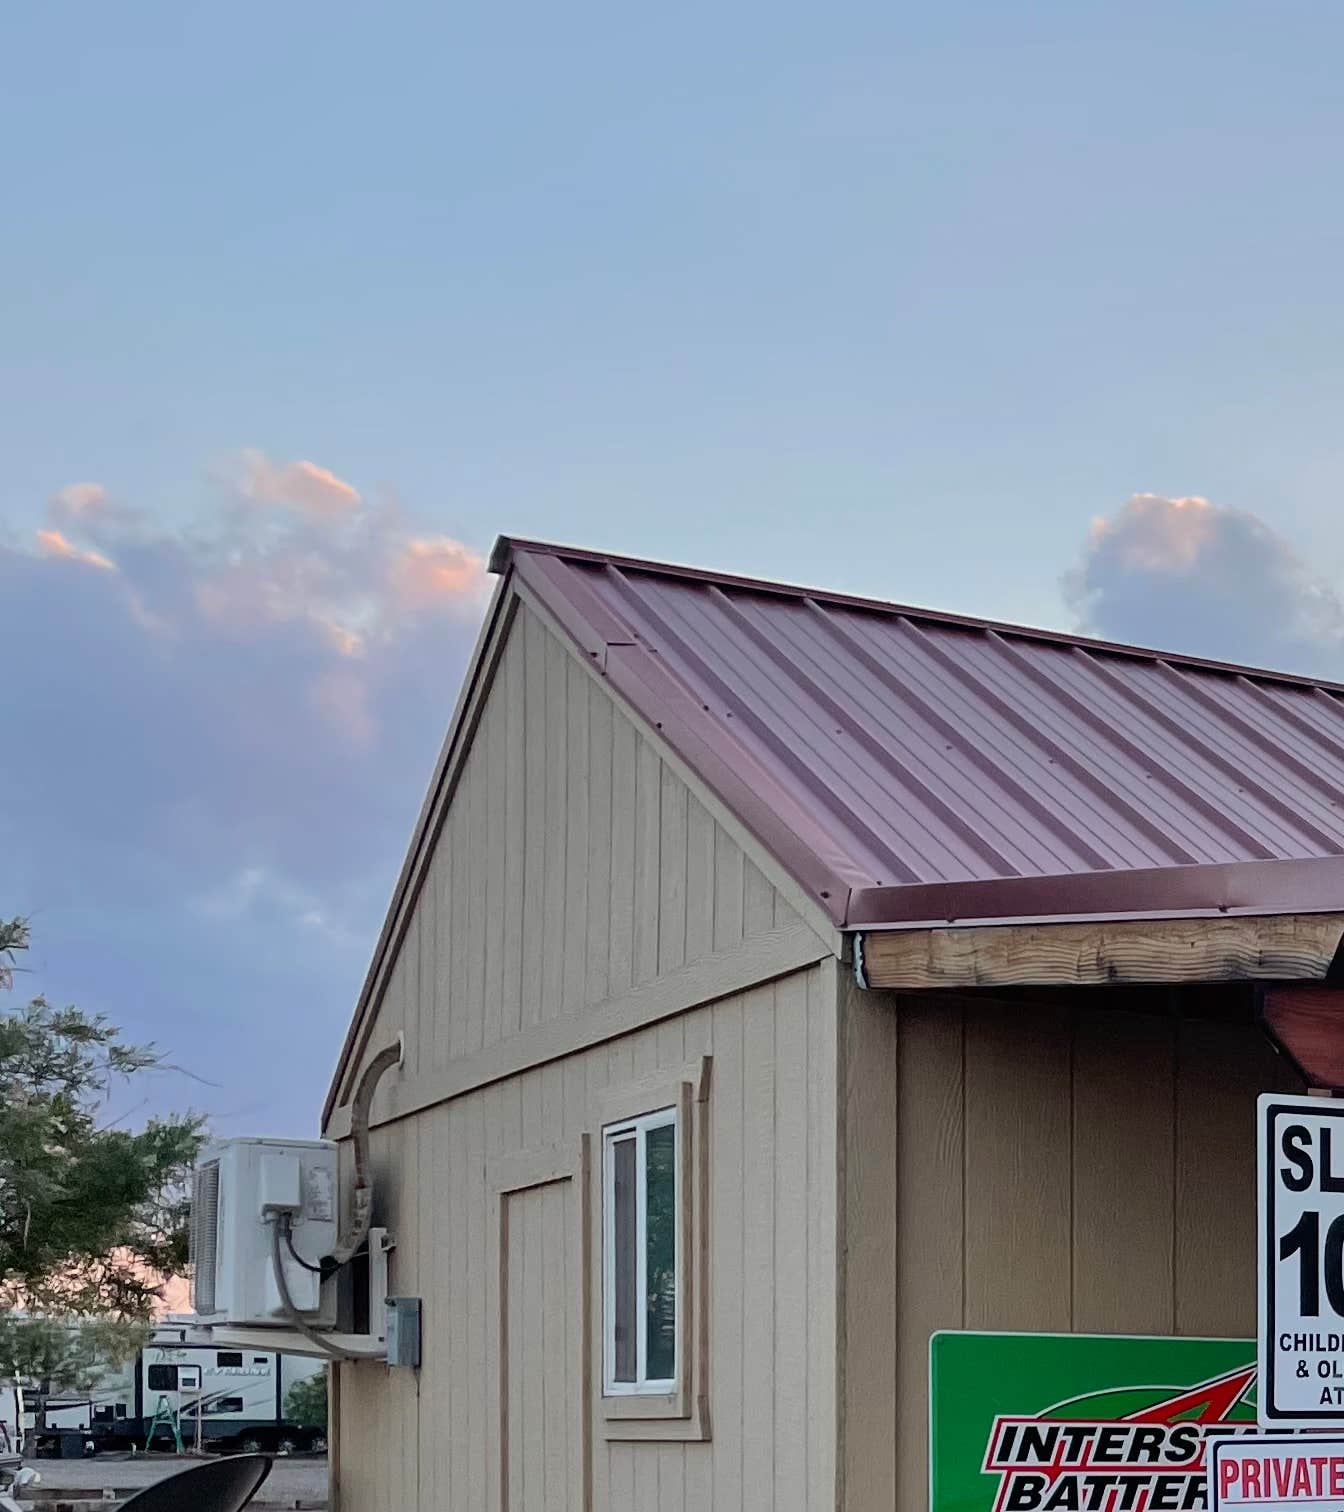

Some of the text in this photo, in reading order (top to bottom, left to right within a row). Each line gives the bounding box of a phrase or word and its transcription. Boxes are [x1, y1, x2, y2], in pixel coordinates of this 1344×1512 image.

[1295, 1360, 1310, 1378] &
[996, 1426, 1300, 1464] INTERS
[1005, 1475, 1208, 1512] BATTER
